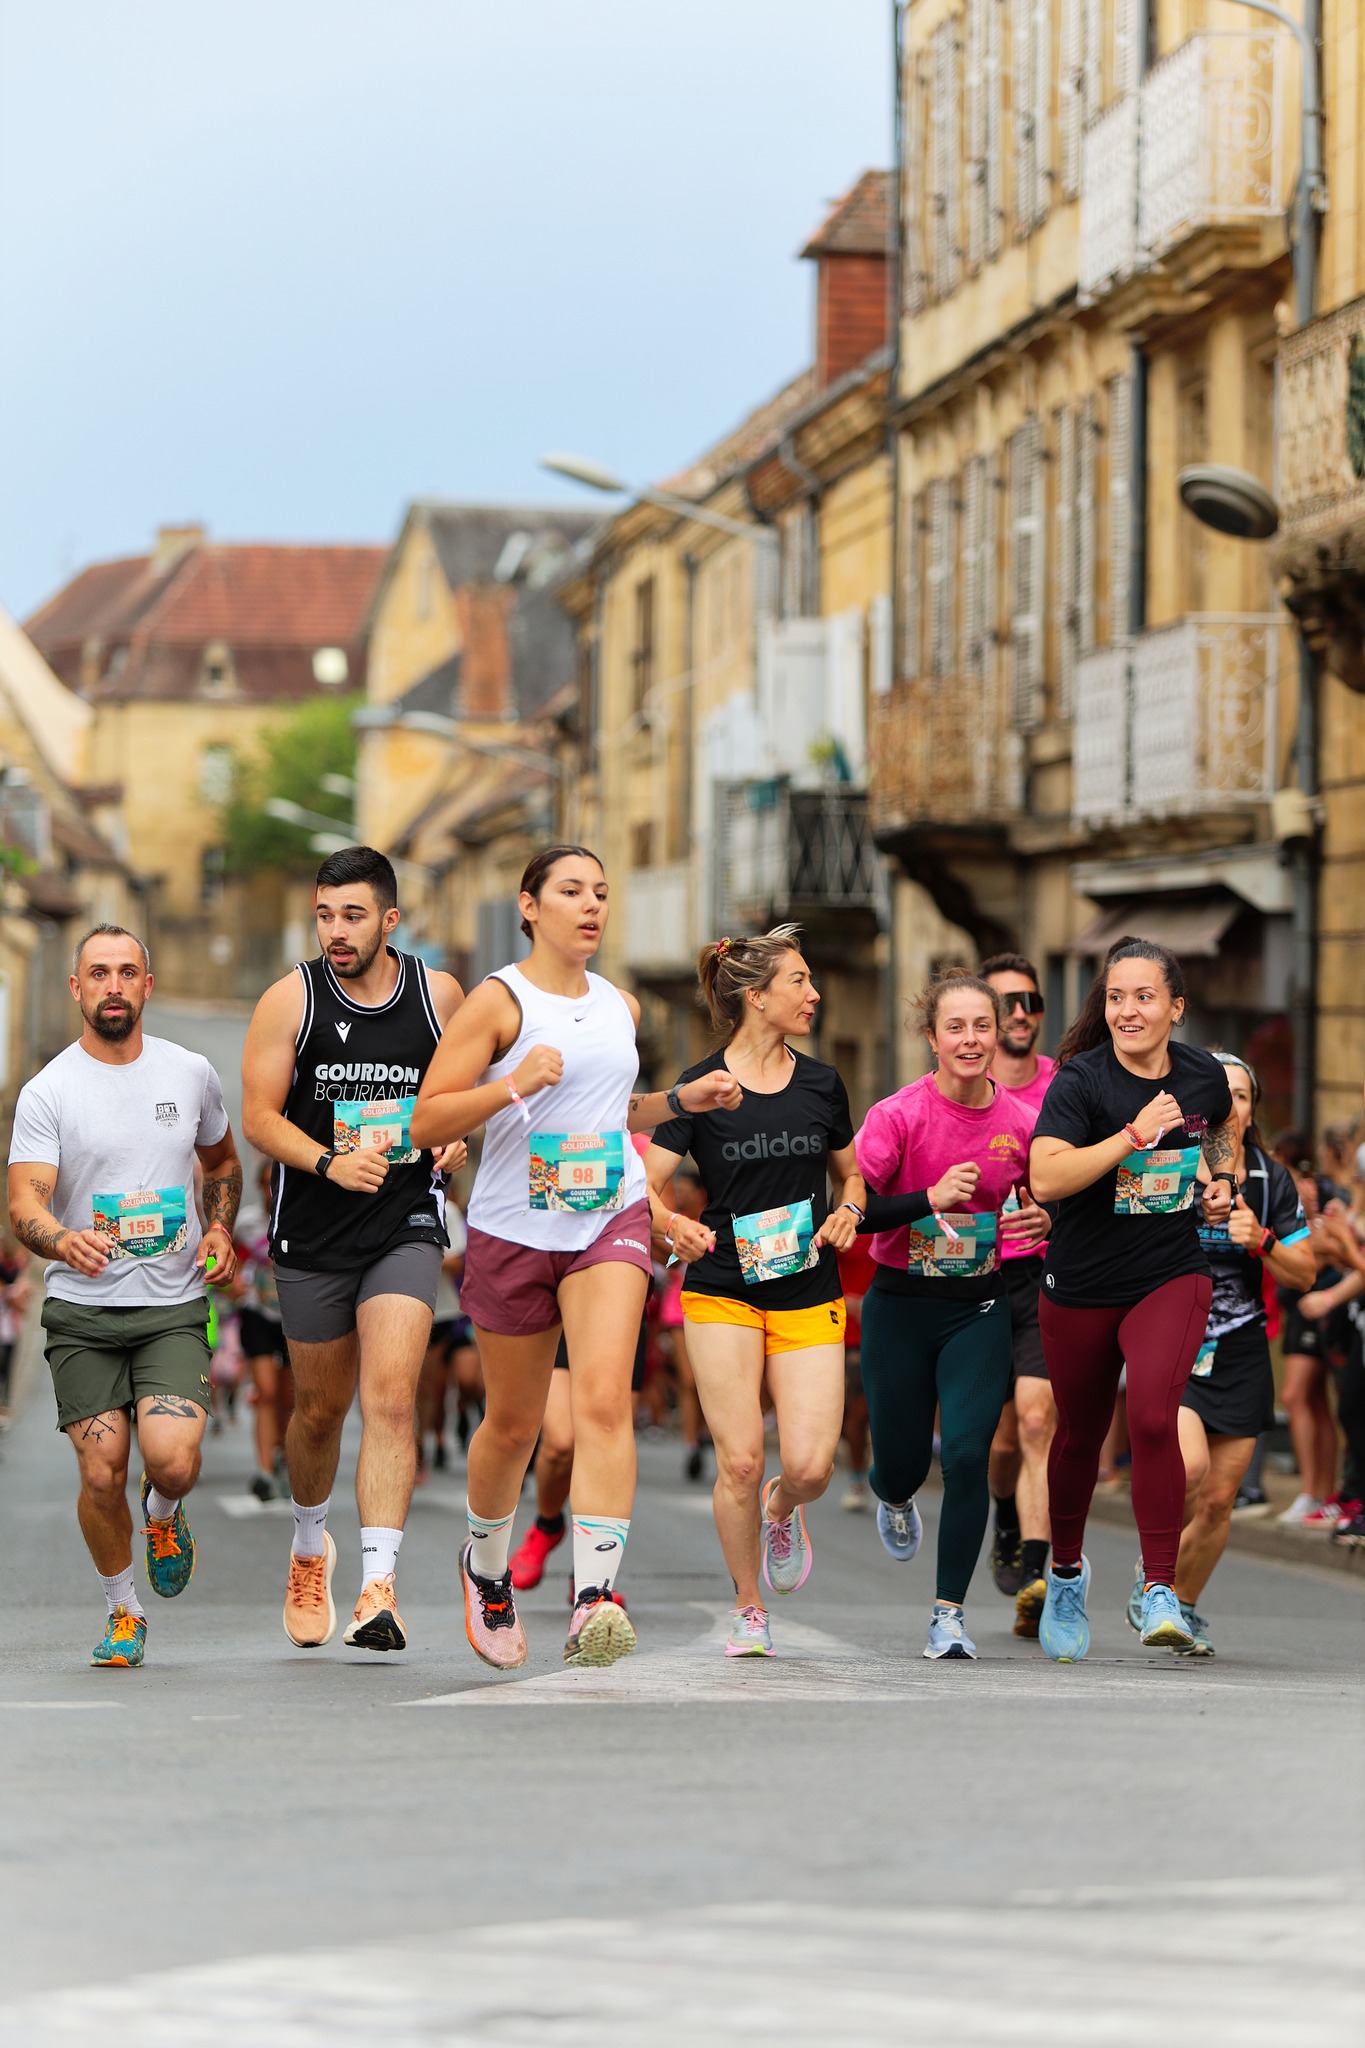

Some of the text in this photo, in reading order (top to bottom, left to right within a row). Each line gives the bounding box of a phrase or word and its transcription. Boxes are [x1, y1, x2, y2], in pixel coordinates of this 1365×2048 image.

[314, 1063, 420, 1084] GOURDON
[314, 1082, 417, 1102] BOURIANE
[362, 1105, 401, 1116] SOLIDARUN
[372, 1129, 389, 1145] 51
[561, 1140, 604, 1151] SOLIDARUN
[721, 1130, 823, 1162] adidas
[1147, 1156, 1182, 1165] SOLIDARUN
[572, 1167, 594, 1184] 98
[1153, 1178, 1170, 1191] 36
[120, 1195, 160, 1208] SOLIDARUN
[127, 1219, 156, 1235] 155
[757, 1212, 792, 1228] SOLIDARUN
[773, 1237, 789, 1252] 41
[945, 1241, 965, 1255] 28
[774, 1254, 796, 1264] GOURDON
[770, 1262, 788, 1271] URBAN
